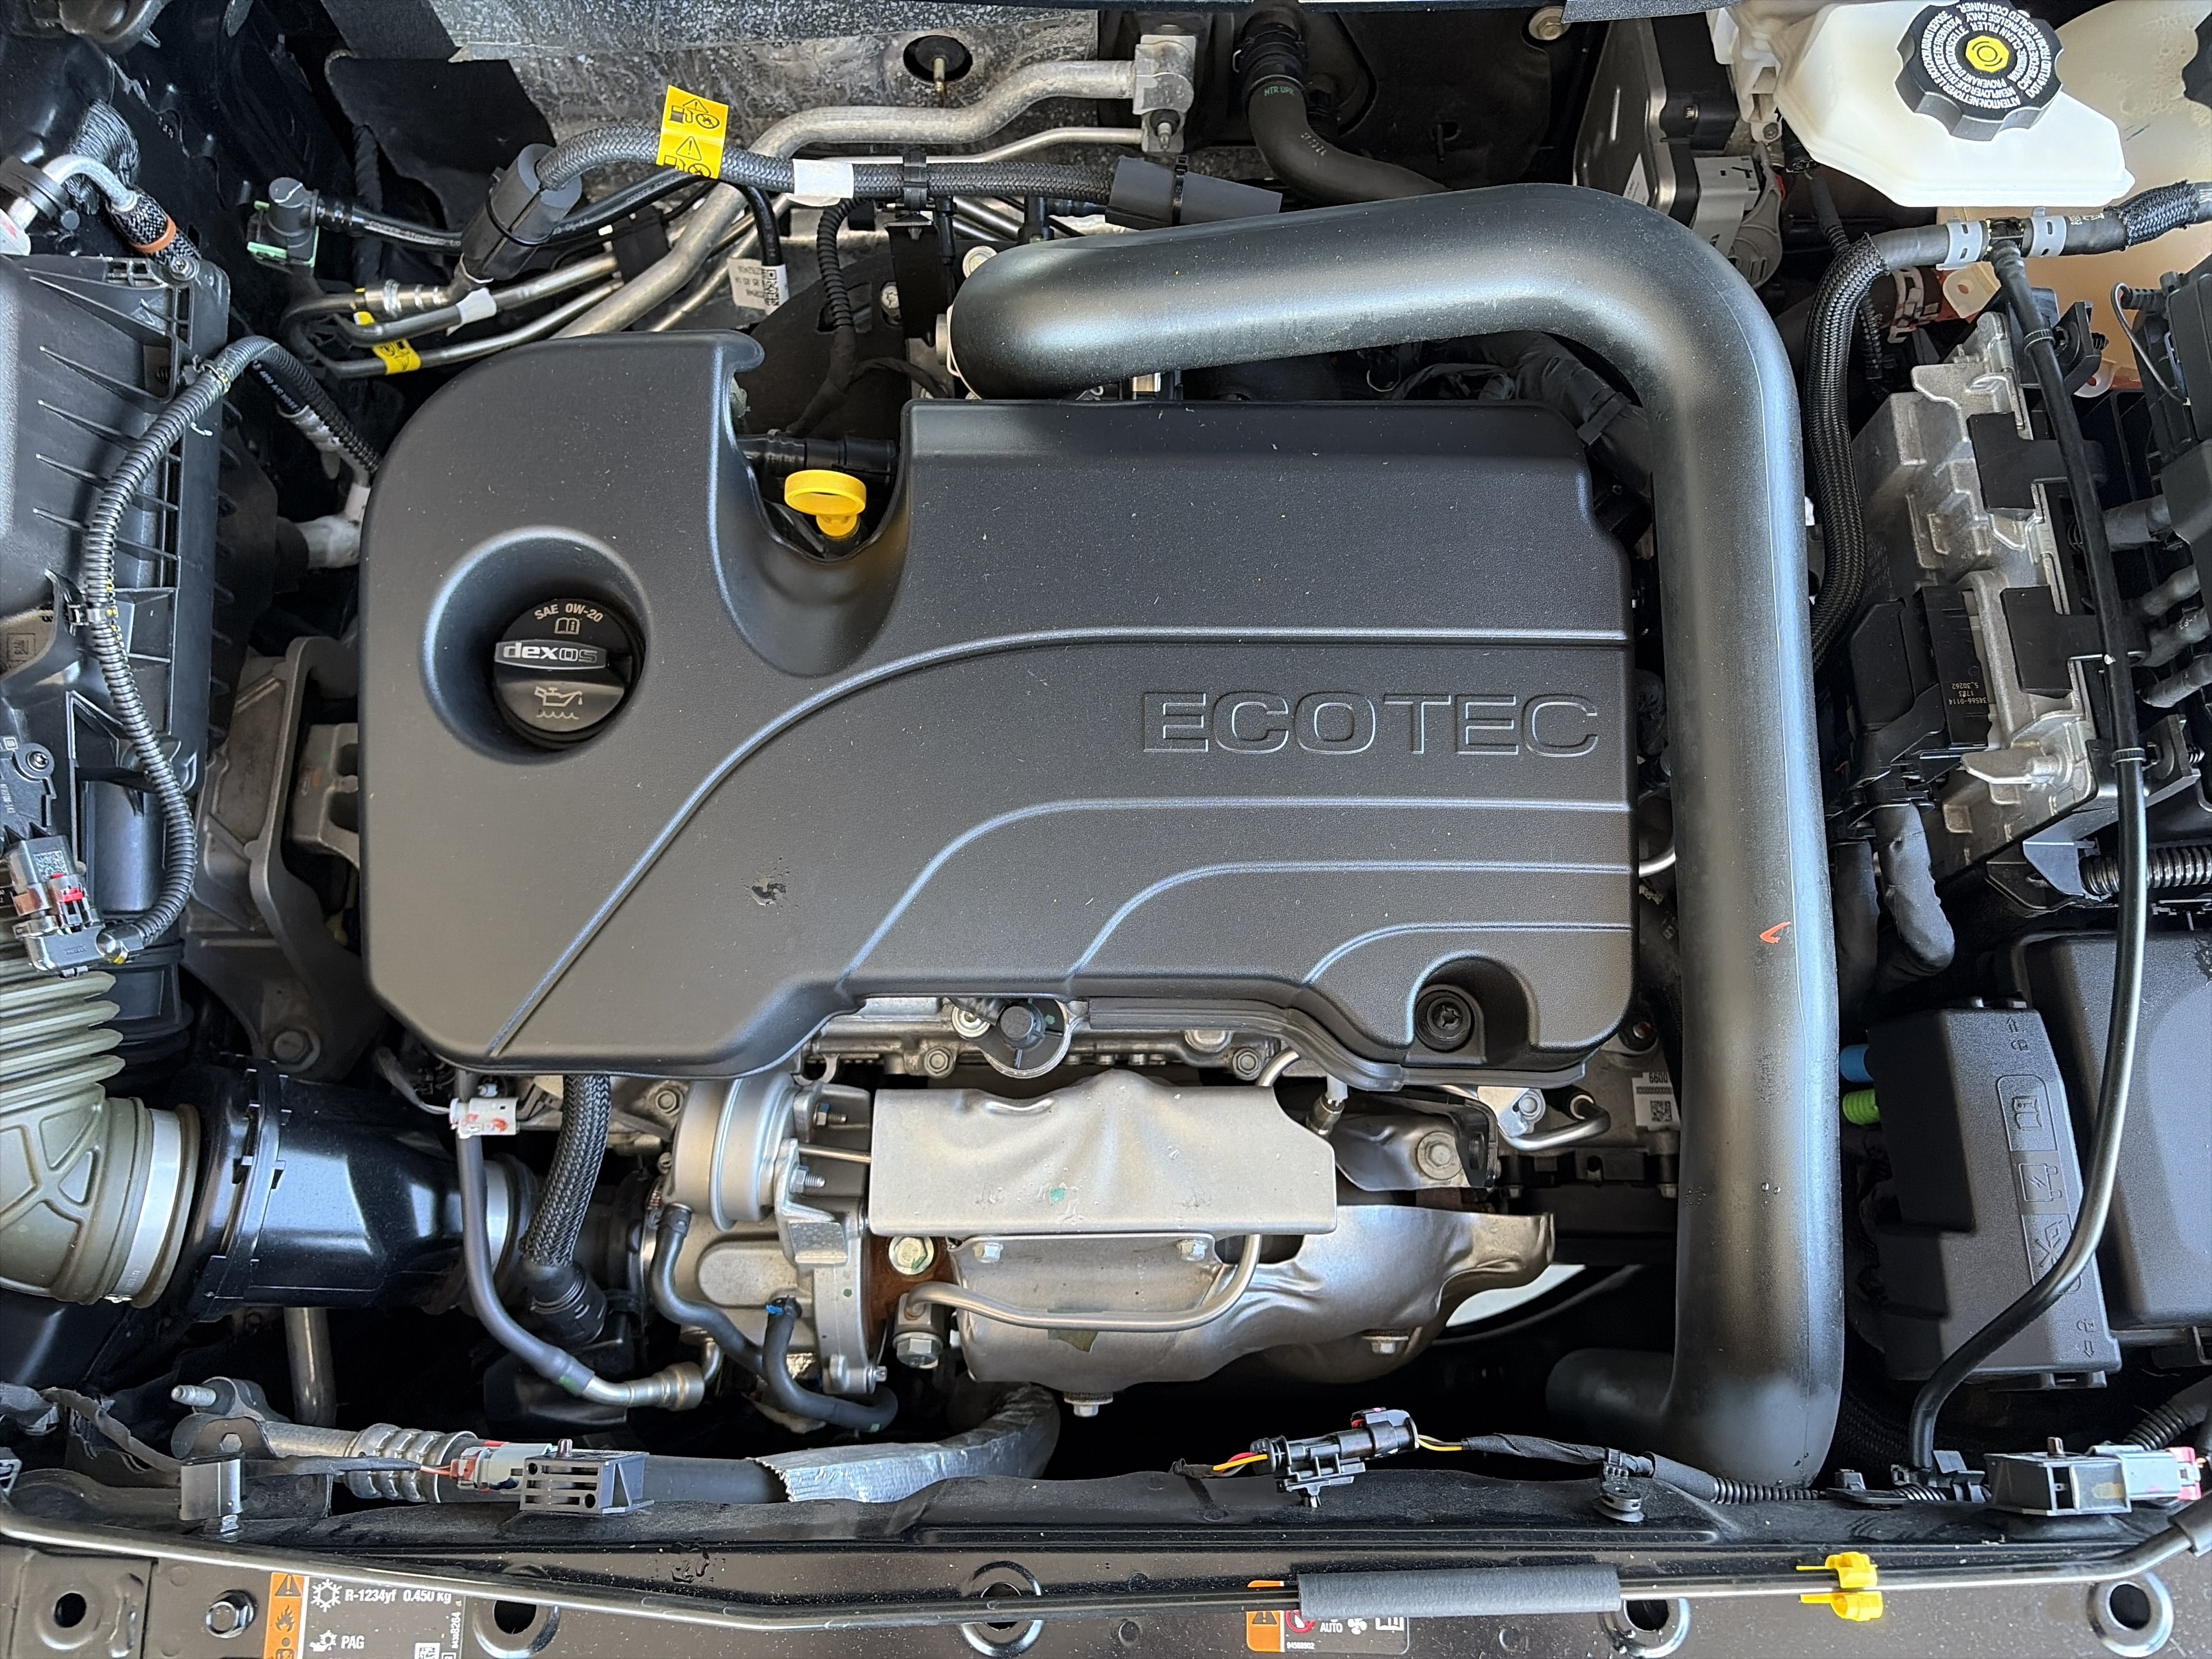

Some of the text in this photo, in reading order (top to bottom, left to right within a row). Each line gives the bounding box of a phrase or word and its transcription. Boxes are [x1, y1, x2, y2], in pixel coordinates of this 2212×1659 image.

[1942, 18, 1957, 31] DOT
[1966, 12, 1987, 22] ONLY
[1988, 13, 2005, 25] USE
[2008, 10, 2038, 35] SEALED
[1934, 27, 1949, 45] FREIN
[1970, 21, 2000, 33] FILLER
[1921, 29, 1934, 50] AVANT
[1999, 27, 2023, 49] CLEAN
[1945, 45, 1957, 64] BIDON
[2035, 38, 2051, 59] FROM
[1921, 49, 1940, 78] BOUCHON
[1934, 53, 1952, 76] LIQUIDE
[2026, 50, 2039, 78] BEFORE
[2038, 60, 2051, 81] FLUID
[1955, 79, 1971, 92] QUE
[1962, 73, 2006, 88] PROVENANT
[2017, 74, 2032, 89] CAP
[1264, 86, 1279, 97] HTR
[1943, 83, 1979, 106] NETTOYER
[2025, 82, 2042, 98] DOT
[534, 603, 603, 622] SAE 0W-20
[504, 642, 597, 663] dexos
[1949, 697, 1987, 706] 34566-0114
[1143, 691, 1598, 757] ECOTEC
[345, 1589, 397, 1604] R-1234yf
[403, 1589, 435, 1602] 0.450
[1319, 1622, 1343, 1633] AUTO
[341, 1635, 365, 1649] PAG
